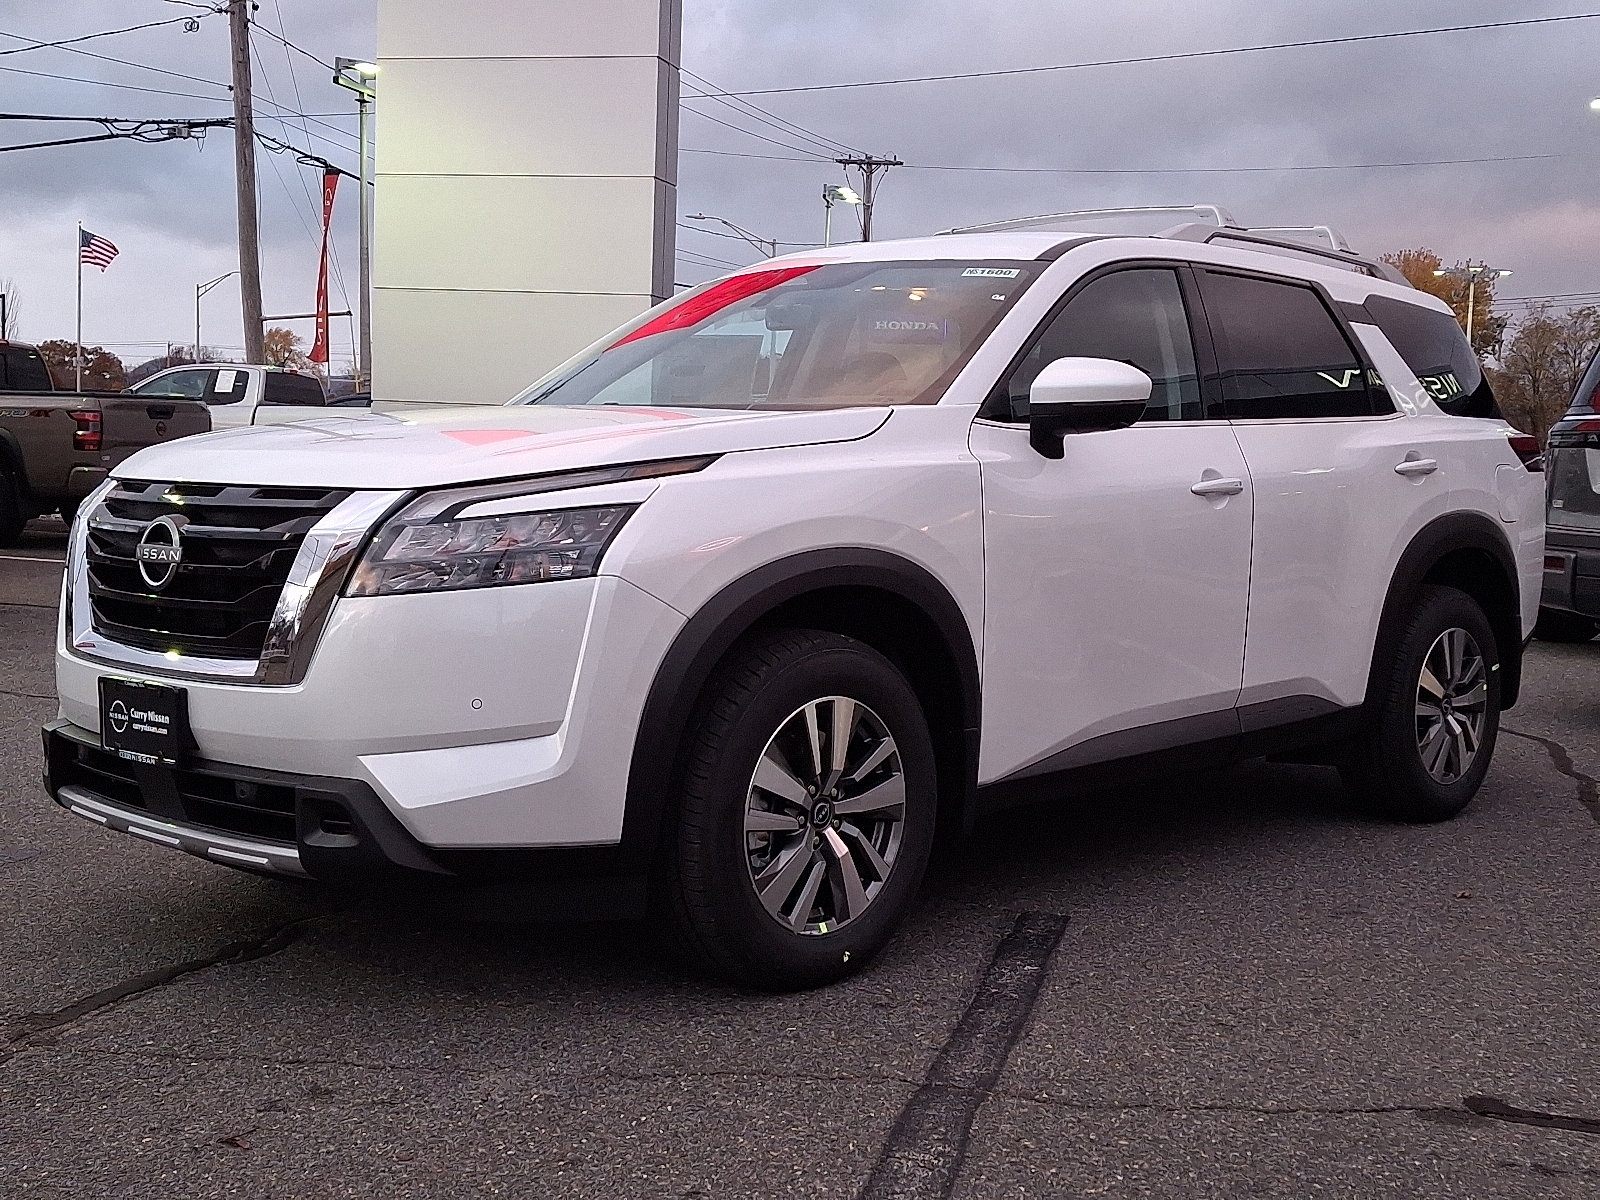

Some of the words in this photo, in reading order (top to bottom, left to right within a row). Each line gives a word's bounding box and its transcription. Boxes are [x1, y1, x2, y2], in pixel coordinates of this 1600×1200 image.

[874, 321, 940, 331] HONDA
[109, 712, 128, 721] NISSAN
[130, 708, 147, 722] Curry
[148, 711, 169, 724] Nissan
